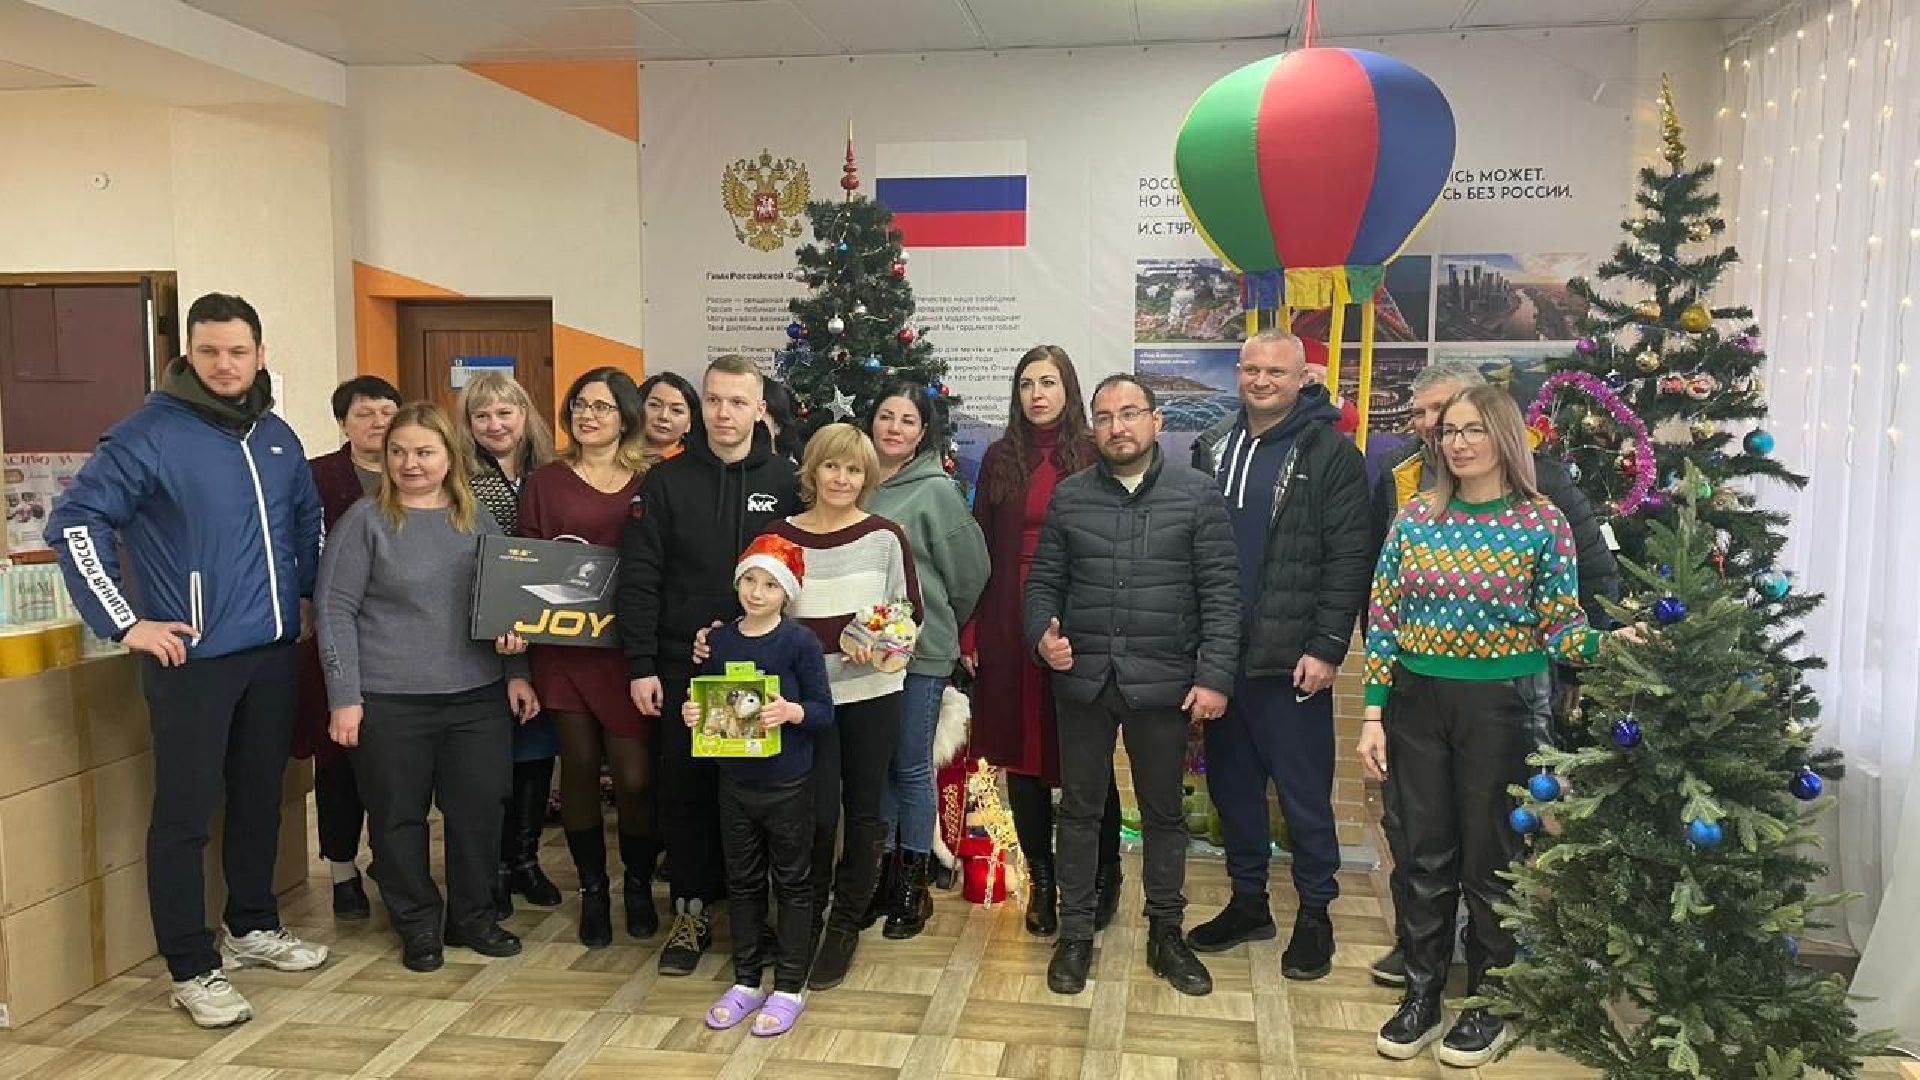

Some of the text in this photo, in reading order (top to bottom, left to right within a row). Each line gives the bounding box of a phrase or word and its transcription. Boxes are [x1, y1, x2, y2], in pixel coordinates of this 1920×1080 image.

[1451, 168, 1546, 184] СЬ МОЖЕТ.
[1139, 177, 1179, 191] РОСС
[1442, 184, 1573, 200] СЬ БЕЗ РОССИИ.
[1139, 193, 1162, 208] НО
[730, 271, 783, 280] Российской
[514, 609, 616, 638] JOY
